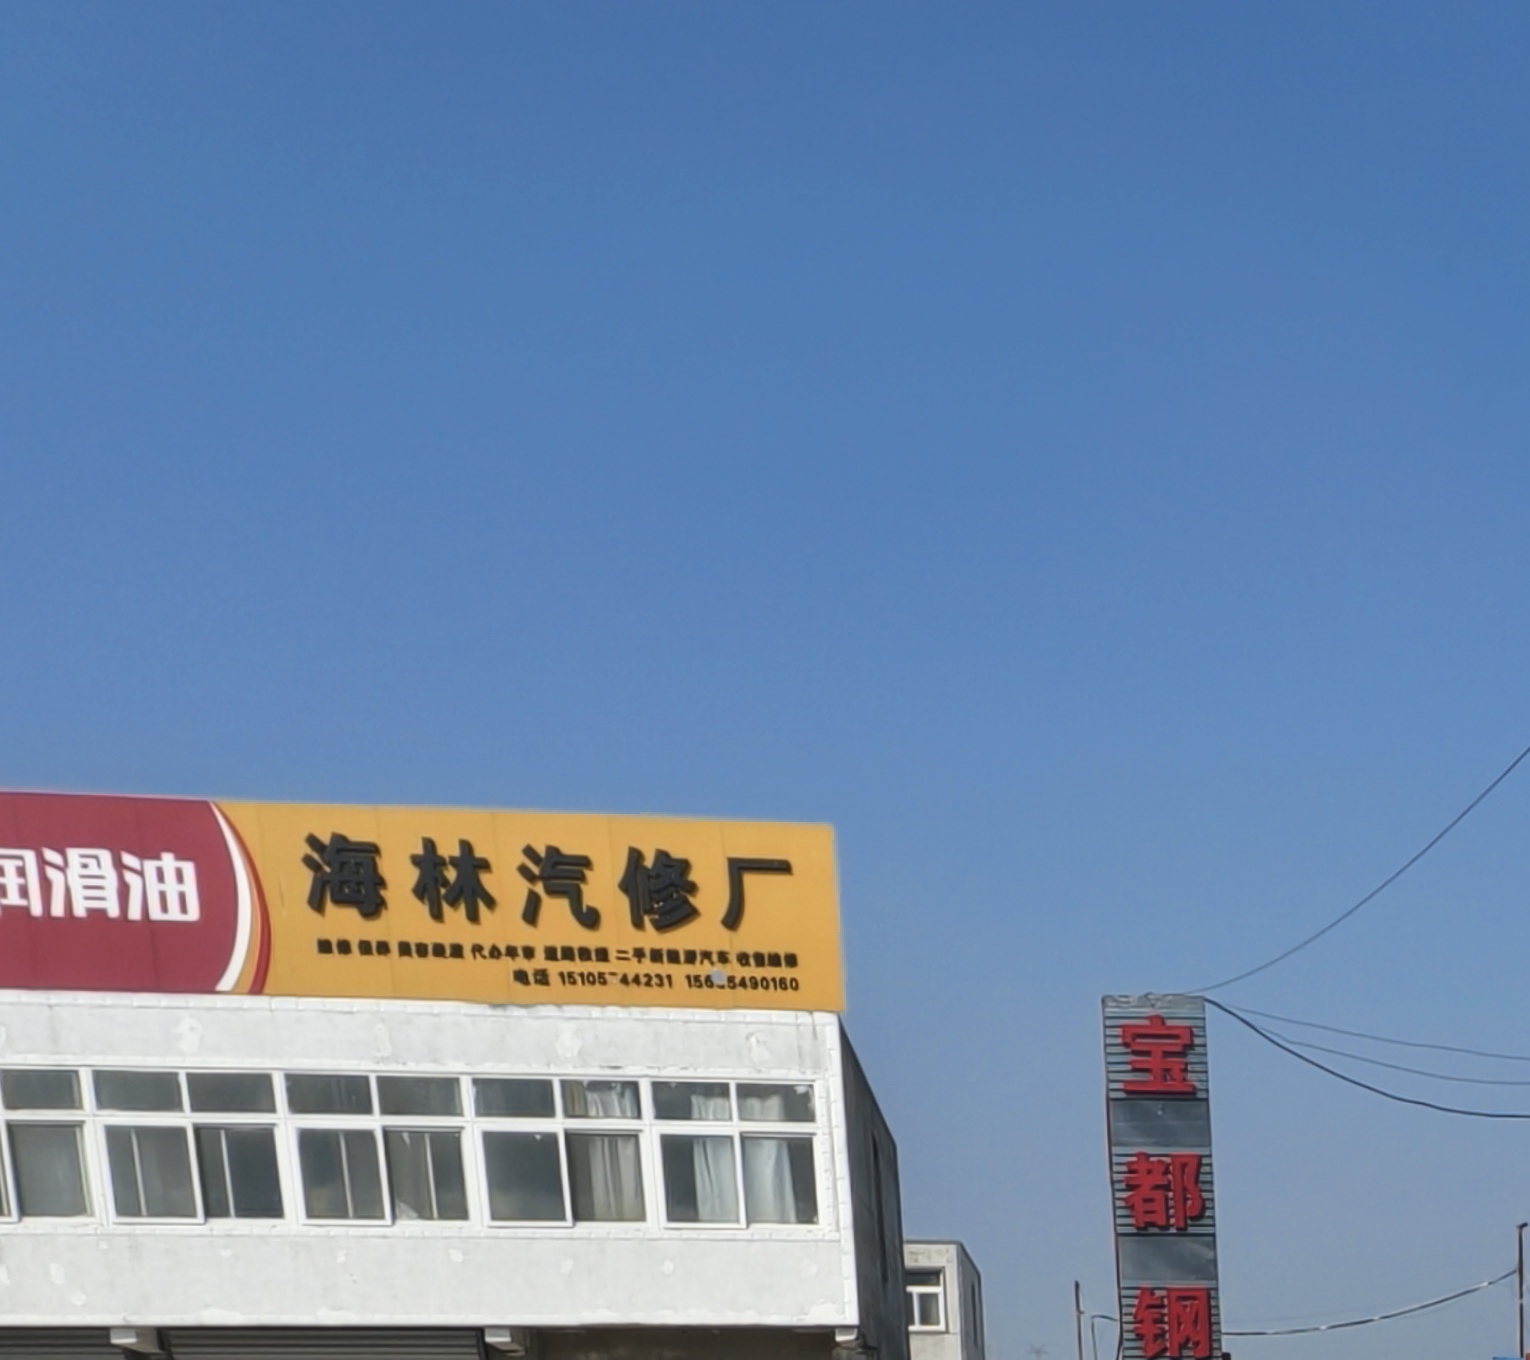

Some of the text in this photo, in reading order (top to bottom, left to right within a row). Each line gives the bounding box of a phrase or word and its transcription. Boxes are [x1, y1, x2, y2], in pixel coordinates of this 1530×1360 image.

[301, 832, 793, 932] 海林汽修厂
[513, 967, 800, 992] 电话 1510544231 1565490160
